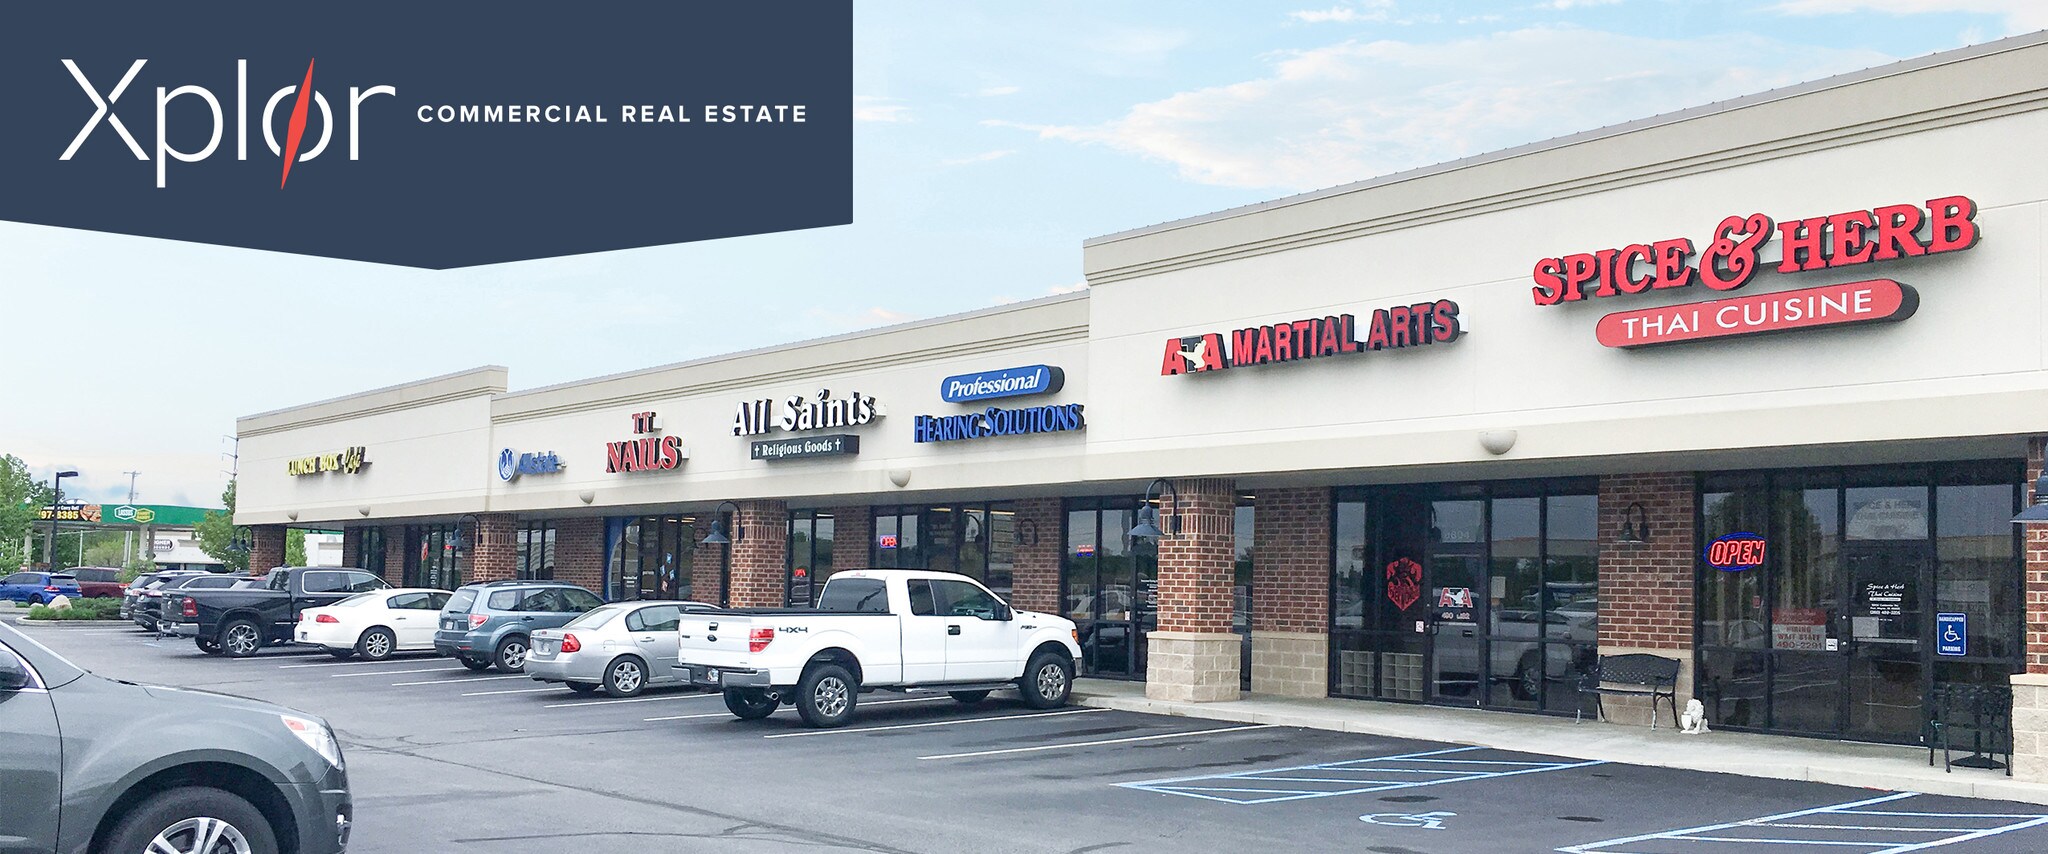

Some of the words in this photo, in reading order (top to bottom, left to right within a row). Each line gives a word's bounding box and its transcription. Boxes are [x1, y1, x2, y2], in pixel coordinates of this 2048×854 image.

[1532, 237, 1697, 306] SPICE
[1699, 212, 1773, 291] &
[1777, 195, 1980, 274] HERB
[1622, 309, 1699, 339] THAI
[1715, 288, 1873, 328] CUISINE
[1231, 314, 1362, 368] MARTIAL
[1368, 299, 1459, 350] ARTS
[947, 368, 1042, 398] Professional
[730, 398, 773, 436] All
[780, 388, 876, 432] Saints
[913, 413, 981, 444] HEARING
[984, 402, 1085, 437] SOLUTIONS
[288, 459, 317, 476] LUNCH
[319, 454, 341, 472] BOX
[605, 435, 683, 474] NAILS
[762, 443, 802, 457] Religious
[804, 438, 833, 453] Goods
[1709, 540, 1766, 565] OPEN
[778, 626, 808, 634] 4X4
